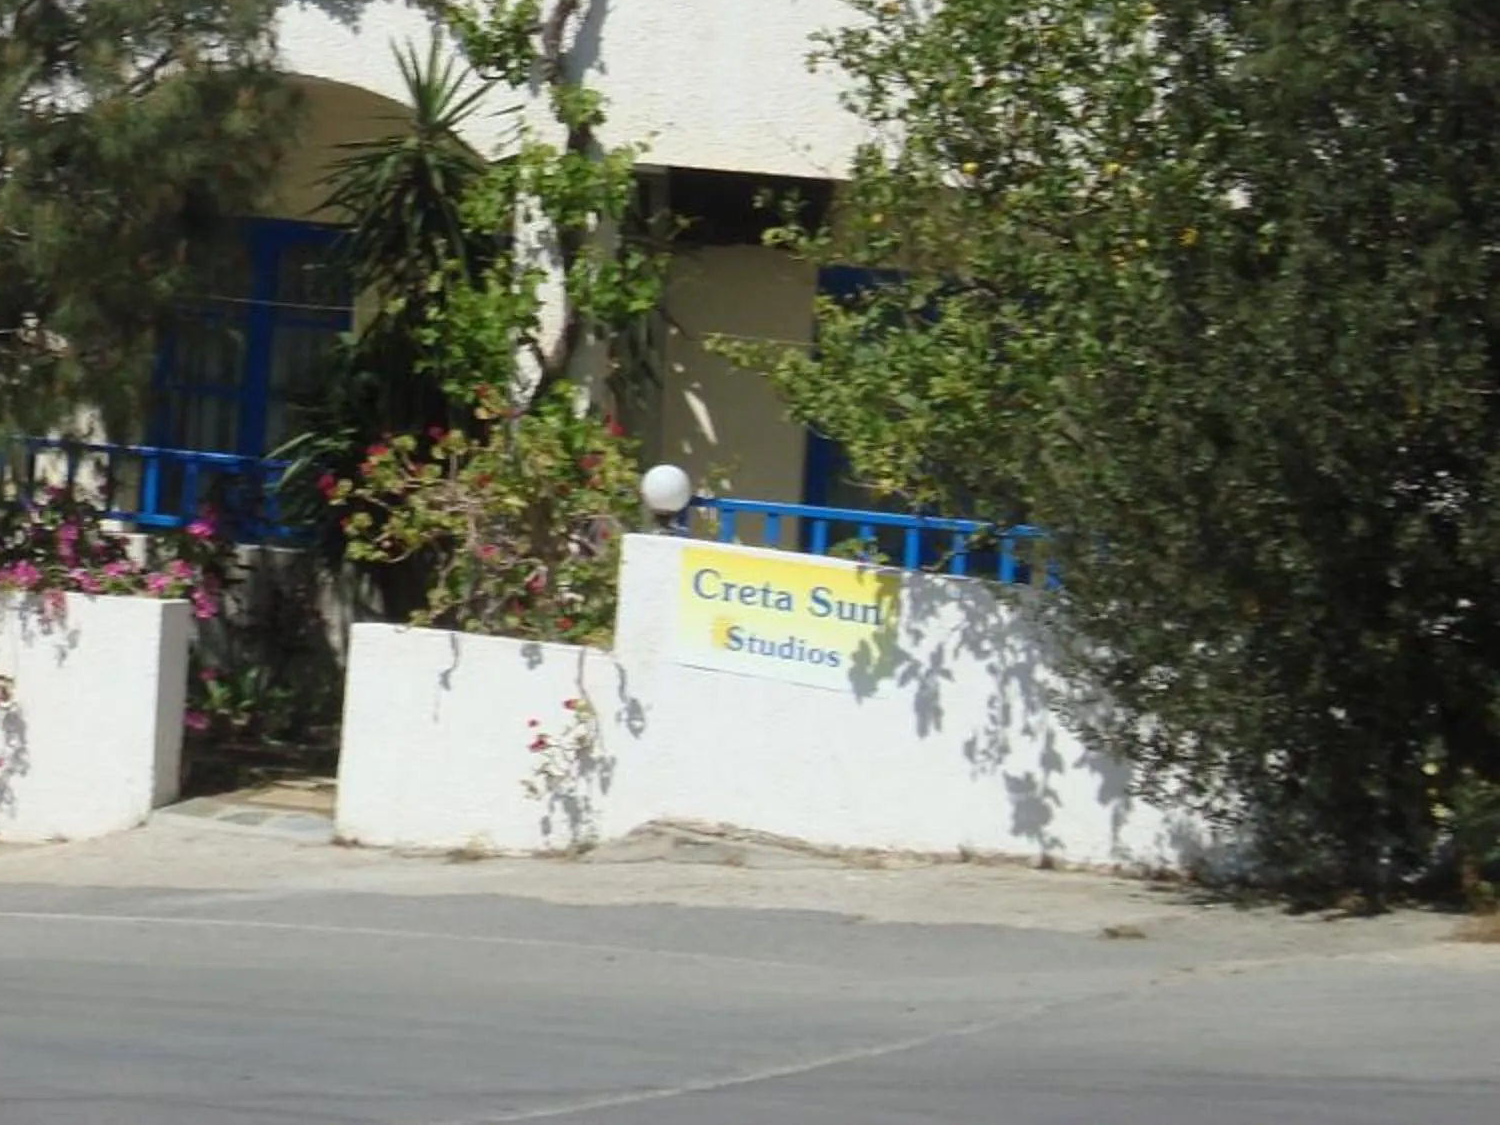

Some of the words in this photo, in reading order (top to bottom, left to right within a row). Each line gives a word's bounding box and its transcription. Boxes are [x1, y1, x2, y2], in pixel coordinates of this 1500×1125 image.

[692, 568, 793, 612] Creta
[807, 586, 881, 625] Sun
[725, 625, 841, 668] Studios
